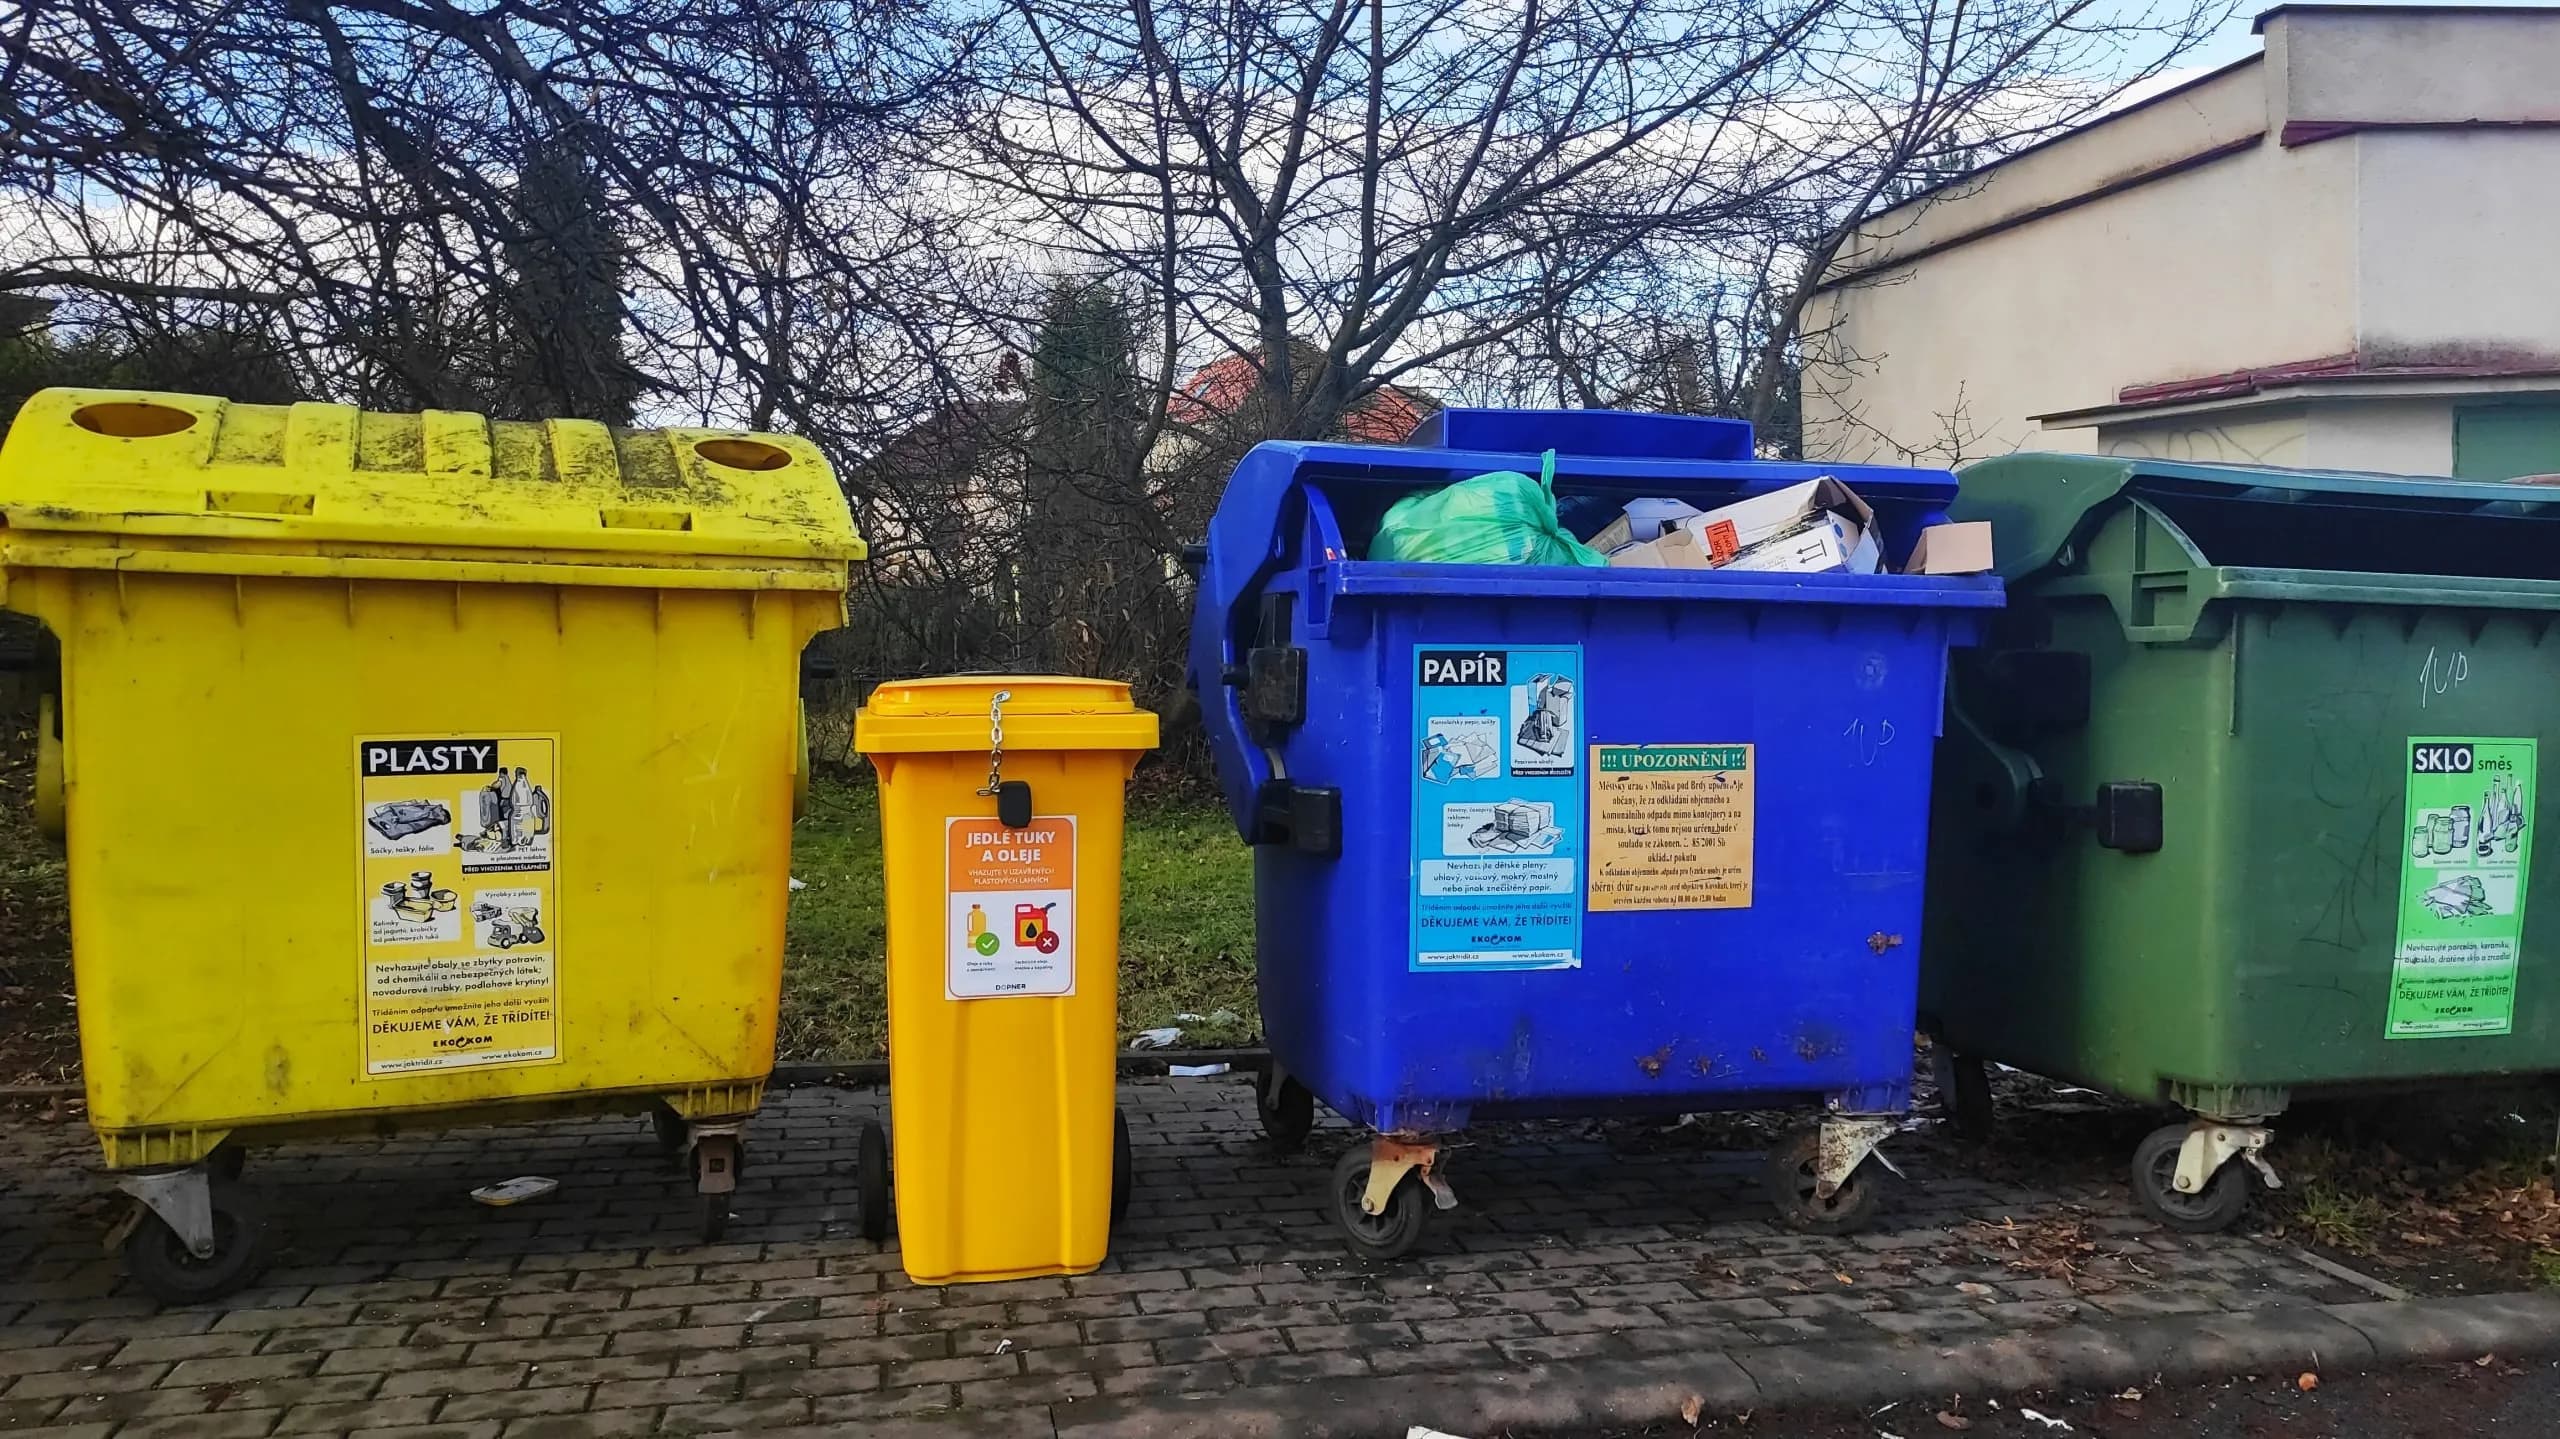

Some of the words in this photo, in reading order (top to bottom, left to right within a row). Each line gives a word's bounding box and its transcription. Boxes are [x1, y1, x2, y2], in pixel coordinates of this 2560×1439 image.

[1424, 652, 1502, 683] PAPÍR
[369, 746, 491, 772] PLASTY
[1622, 750, 1727, 768] UPOZORNĚNÍ
[2415, 748, 2472, 772] SKLO
[2478, 756, 2512, 770] směs
[965, 829, 1010, 849] JEDLÉ
[1014, 831, 1056, 844] TUKY
[982, 849, 994, 862] A
[997, 849, 1041, 864] OLEJE
[968, 869, 1001, 877] VHAZUJTE
[1421, 915, 1479, 928] DĚKUJEME
[1482, 915, 1511, 927] VÁM,
[1515, 915, 1527, 926] ŽE
[1531, 914, 1572, 926] TŘÍDÍTE!
[376, 963, 429, 973] Nevhazujte
[431, 960, 458, 971] obaly
[473, 957, 503, 968] zbytky
[377, 976, 390, 985] od
[450, 967, 515, 981] nebezpečných
[2399, 987, 2444, 1000] DĚKUJEME
[483, 1000, 501, 1010] jeho
[372, 1018, 442, 1034] DĚKUJEME
[446, 1015, 479, 1028] VÁM,
[483, 1012, 498, 1025] ŽE
[502, 1010, 550, 1024] TŘÍDÍTE!
[481, 1049, 543, 1060] www.ekokom.cz
